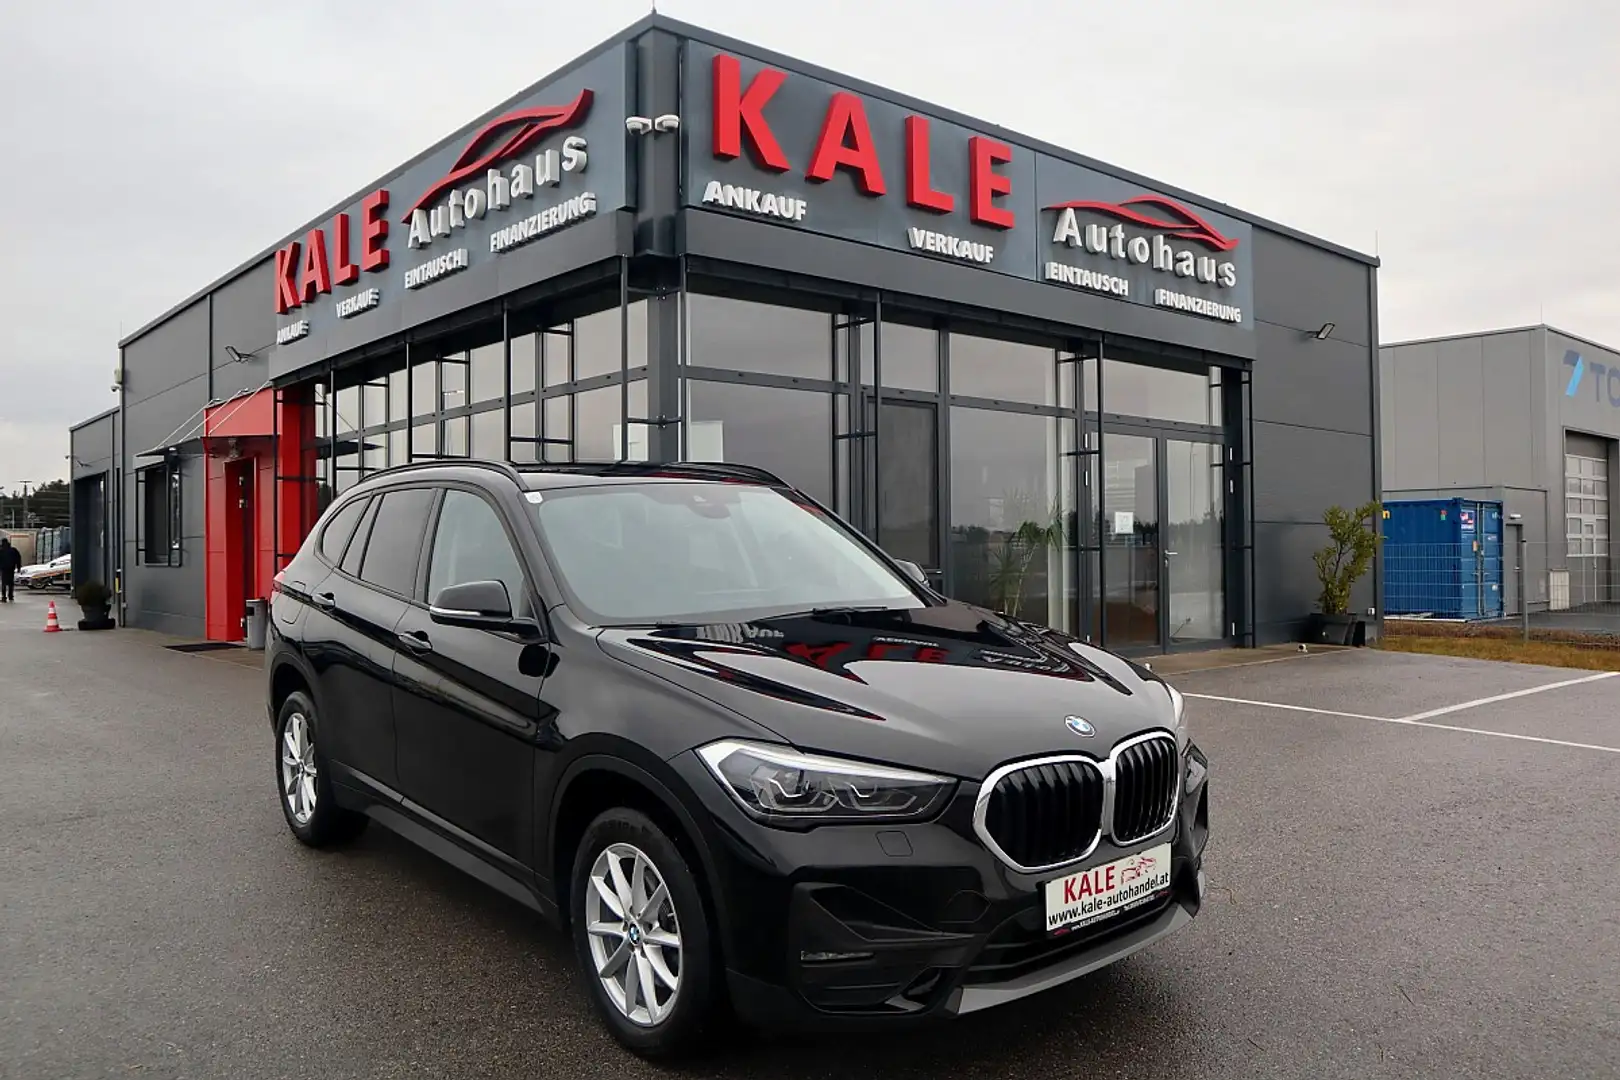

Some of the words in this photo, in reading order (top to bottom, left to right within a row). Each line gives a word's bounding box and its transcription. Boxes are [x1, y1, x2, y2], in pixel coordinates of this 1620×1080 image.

[274, 189, 390, 314] KALE
[407, 136, 588, 249] Autohaus
[712, 53, 1015, 230] KALE
[1053, 207, 1237, 287] Autohaus
[336, 288, 380, 318] VERKAUF
[404, 248, 468, 289] EINTAUSCH
[490, 192, 597, 253] FINANZIERUNG
[702, 180, 807, 221] ANKAUF
[907, 227, 994, 264] VERKAUF
[1045, 262, 1129, 296] EINTAUSCH
[1154, 288, 1242, 323] FINANZIERUNG
[1048, 872, 1169, 926] www.kale-autohandel.at
[1064, 866, 1116, 904] KALE
